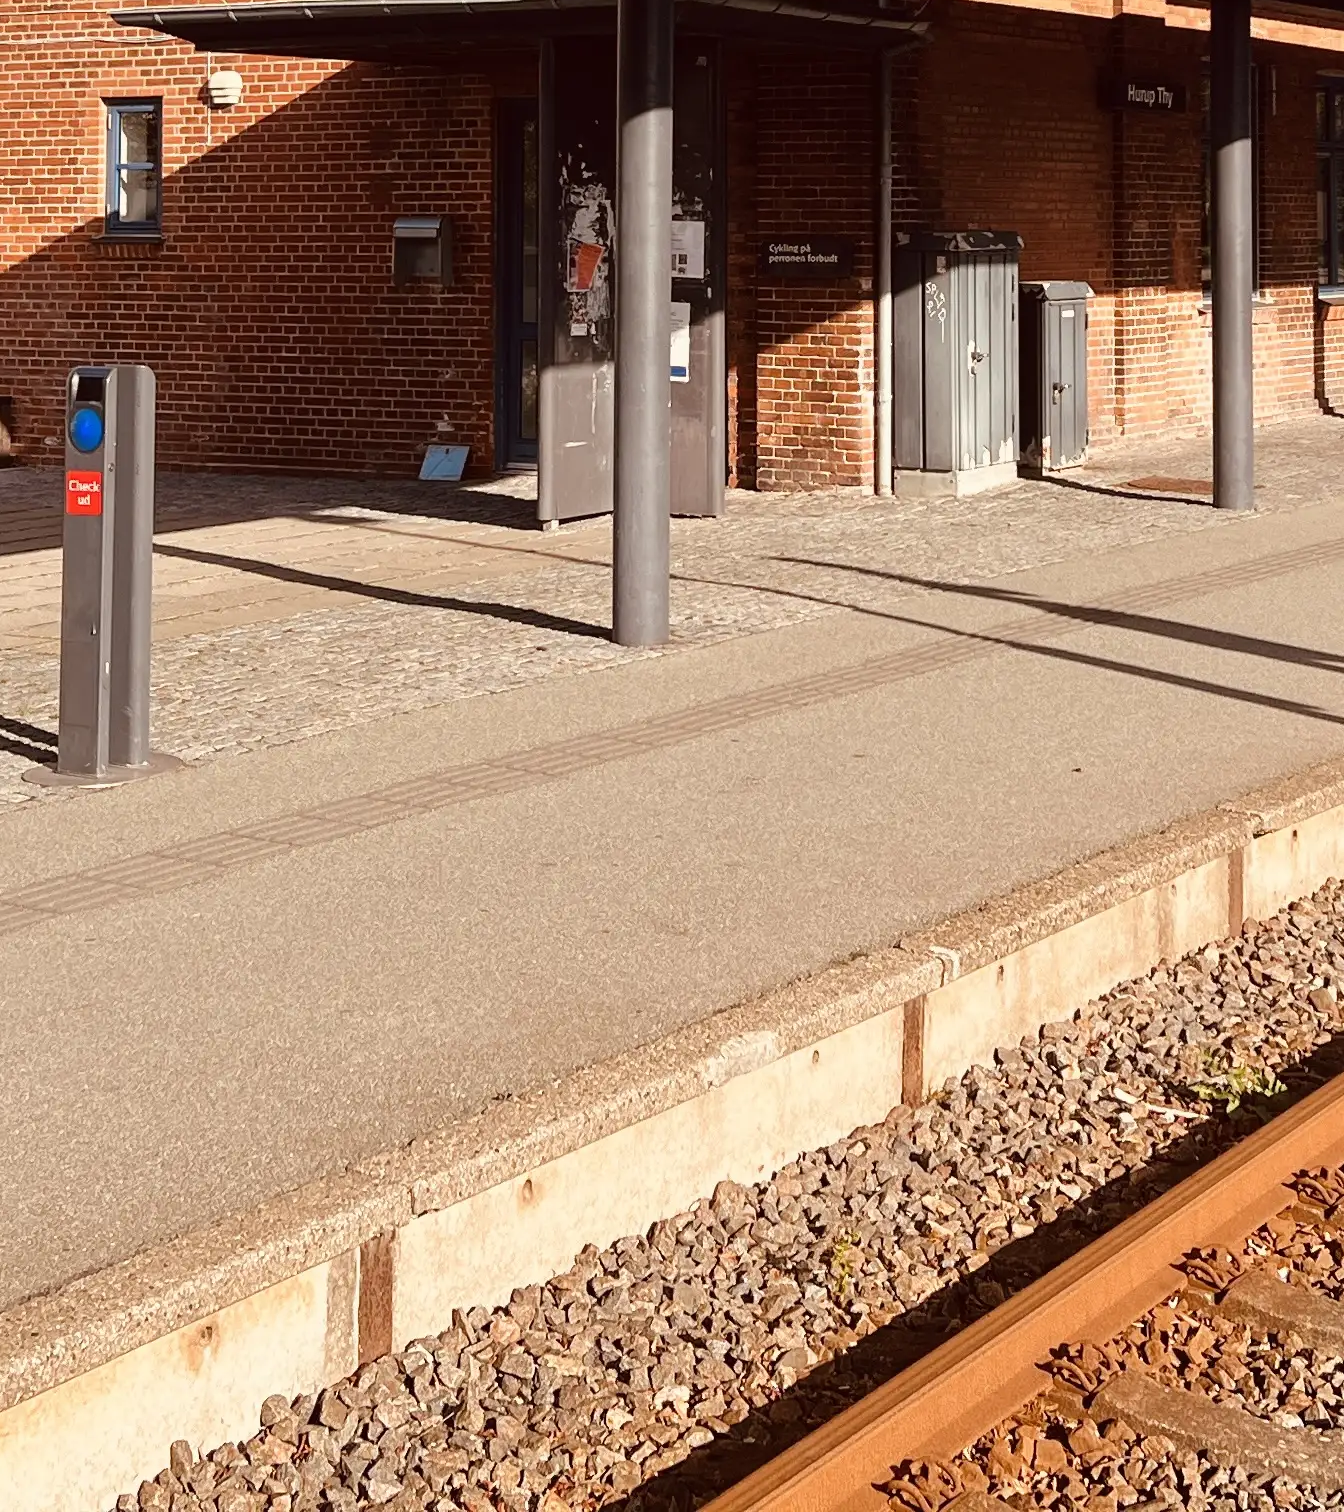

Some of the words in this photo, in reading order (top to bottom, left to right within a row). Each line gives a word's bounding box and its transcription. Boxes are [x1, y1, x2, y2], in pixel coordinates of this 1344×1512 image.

[1127, 84, 1156, 107] Hurup
[1156, 86, 1174, 109] Thy
[768, 243, 798, 254] Cykling
[800, 243, 811, 254] på
[768, 255, 806, 264] perronen
[807, 254, 838, 263] forbudt
[68, 479, 101, 492] Check
[77, 494, 91, 505] ud
